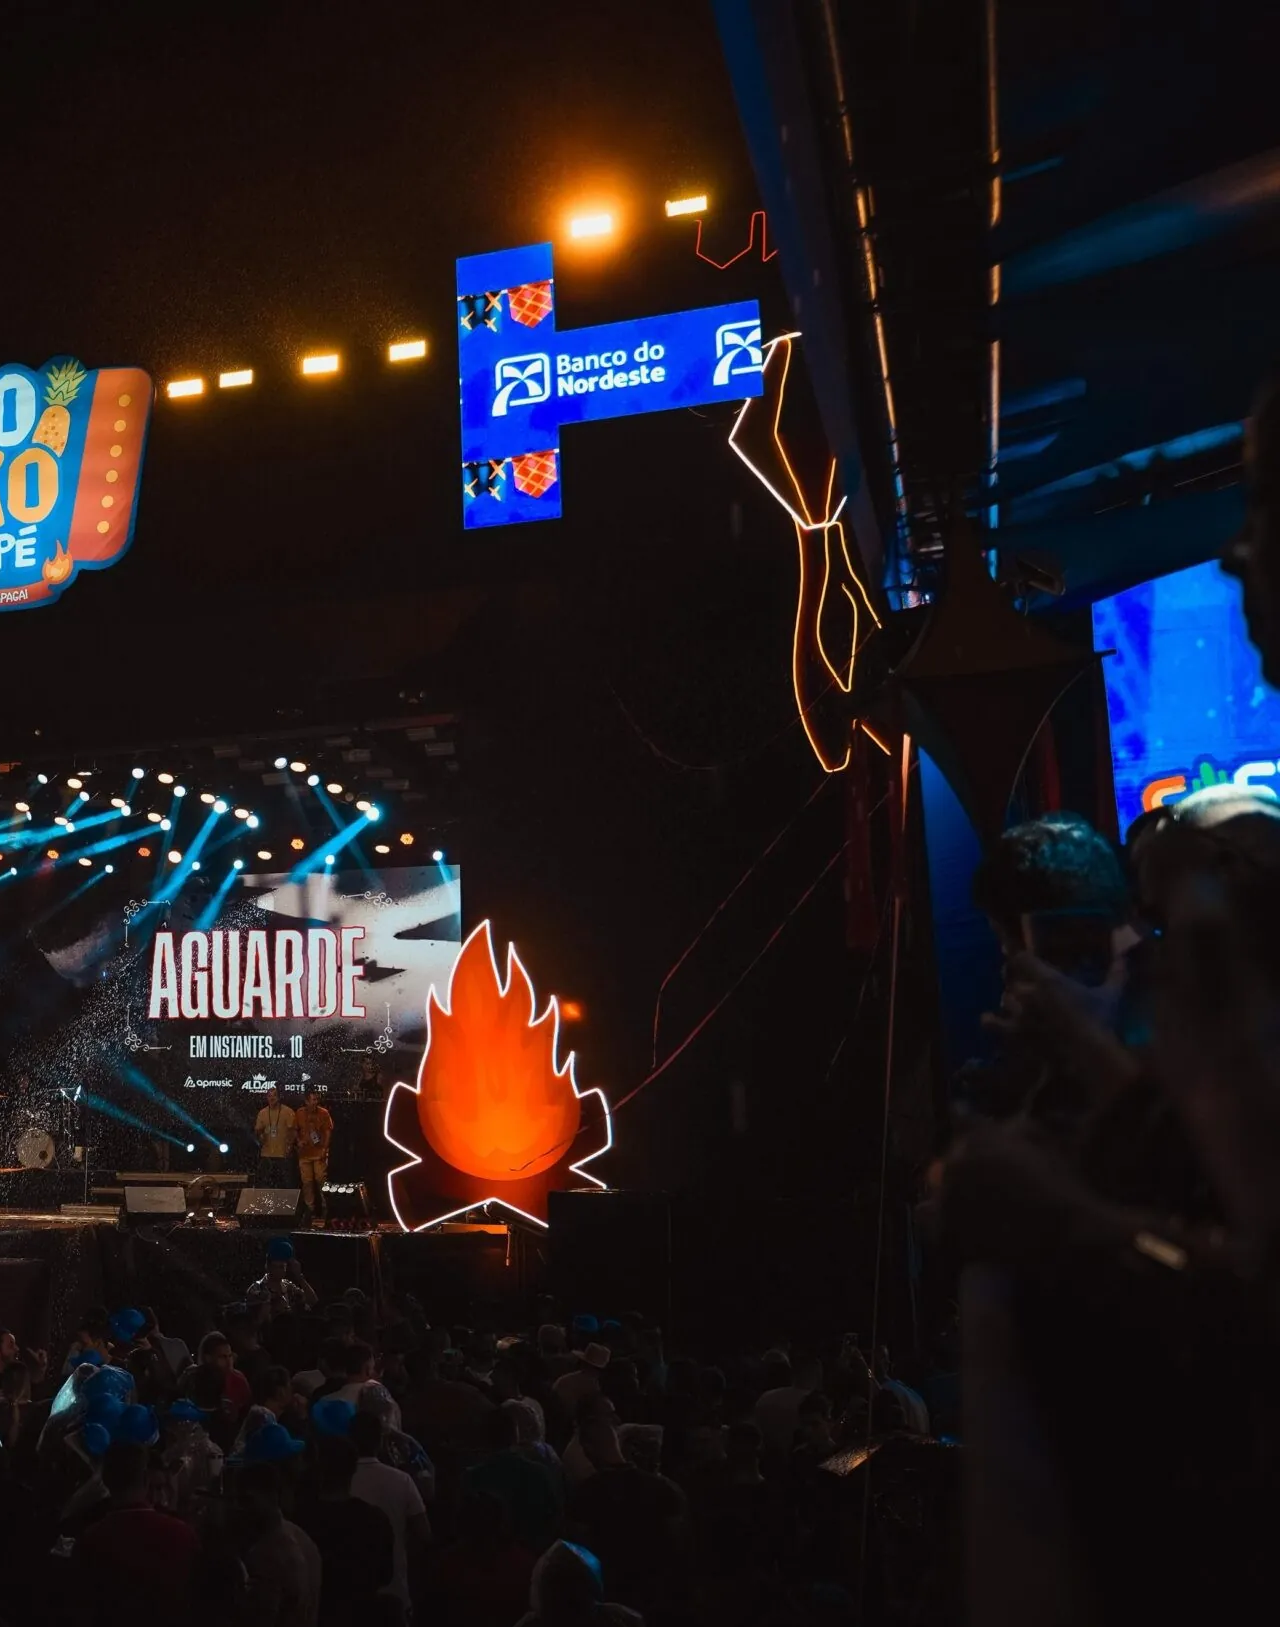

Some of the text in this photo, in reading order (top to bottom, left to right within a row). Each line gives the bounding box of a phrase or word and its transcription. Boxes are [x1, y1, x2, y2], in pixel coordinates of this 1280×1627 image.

[556, 341, 665, 375] Banco do
[557, 365, 666, 397] Nordeste
[148, 926, 367, 1019] AGUARDE
[190, 1034, 303, 1058] EM INSTANTES... 10
[196, 1077, 233, 1088] apmusic
